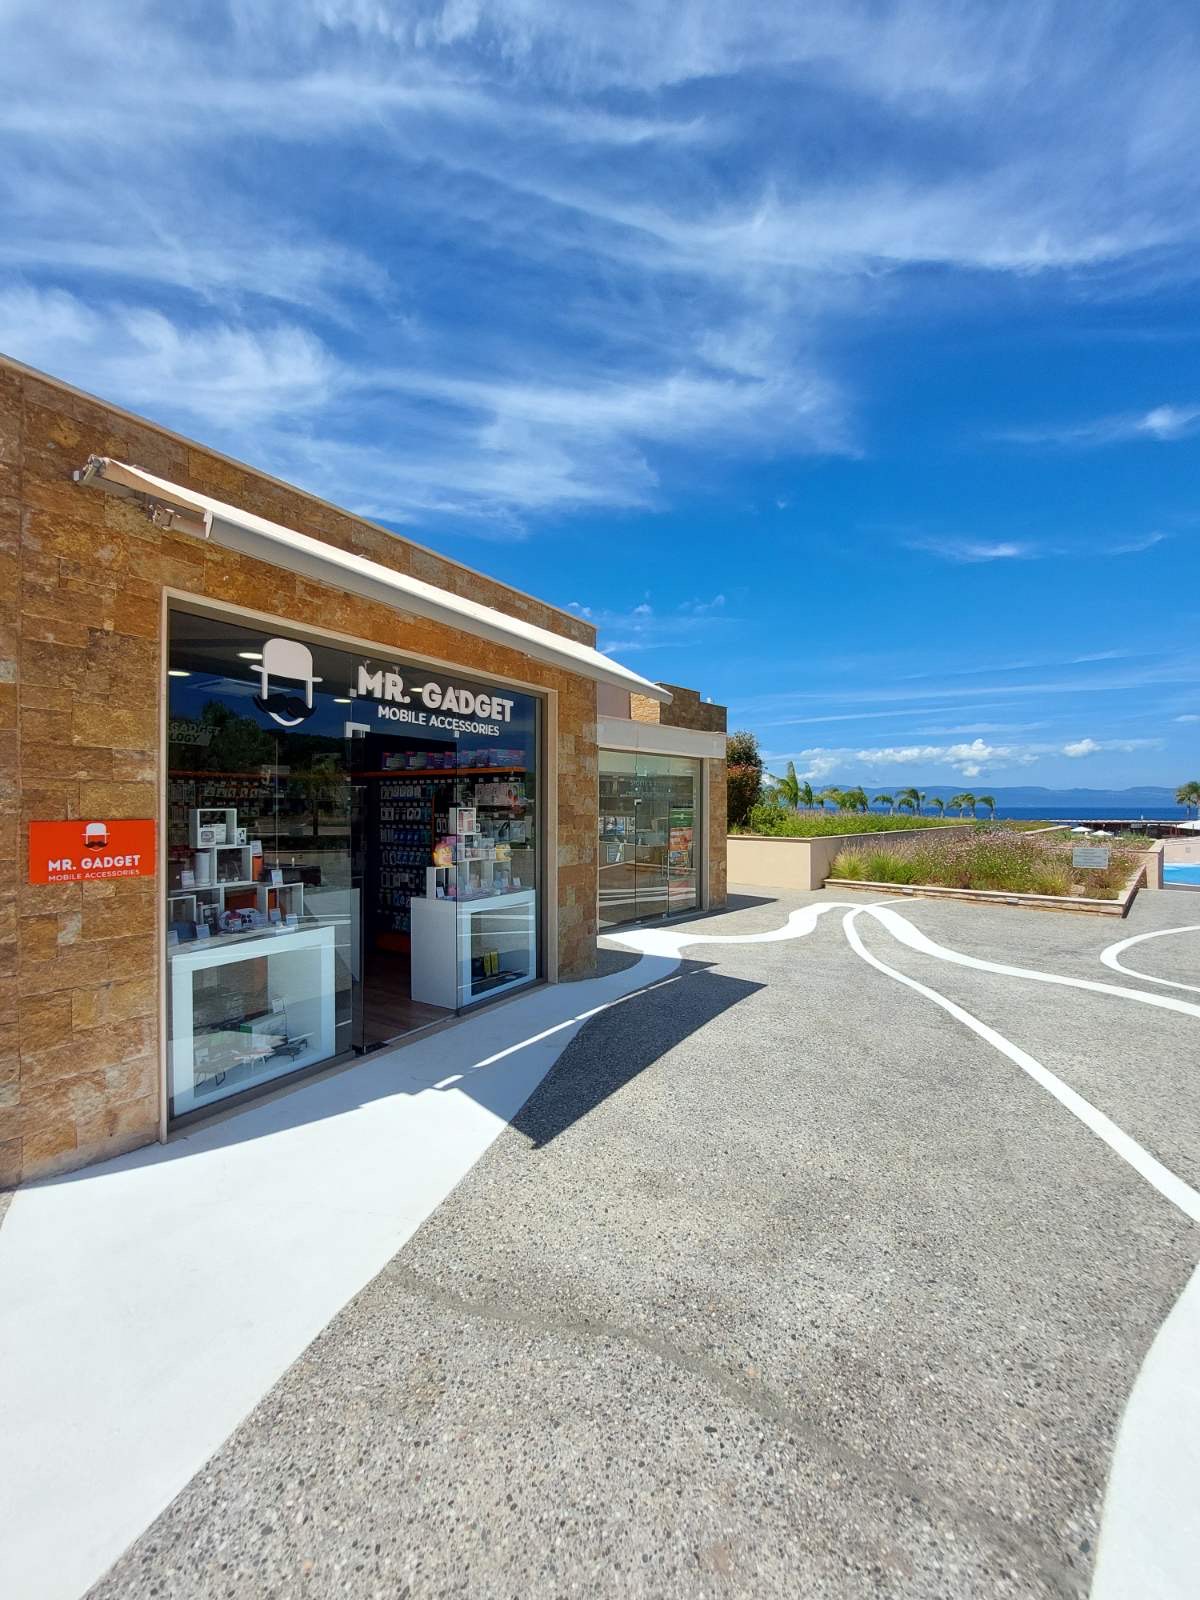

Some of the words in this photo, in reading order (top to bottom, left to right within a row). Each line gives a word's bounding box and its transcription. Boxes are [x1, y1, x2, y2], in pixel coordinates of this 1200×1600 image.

[358, 665, 411, 704] MR.
[421, 682, 514, 722] GADGET
[378, 705, 427, 725] MOBILE
[429, 715, 500, 737] ACCESSORIES
[48, 858, 77, 872] MR.
[81, 854, 141, 870] GADGET
[48, 873, 82, 881] MOBILE
[84, 869, 140, 879] ACCESSORIES
